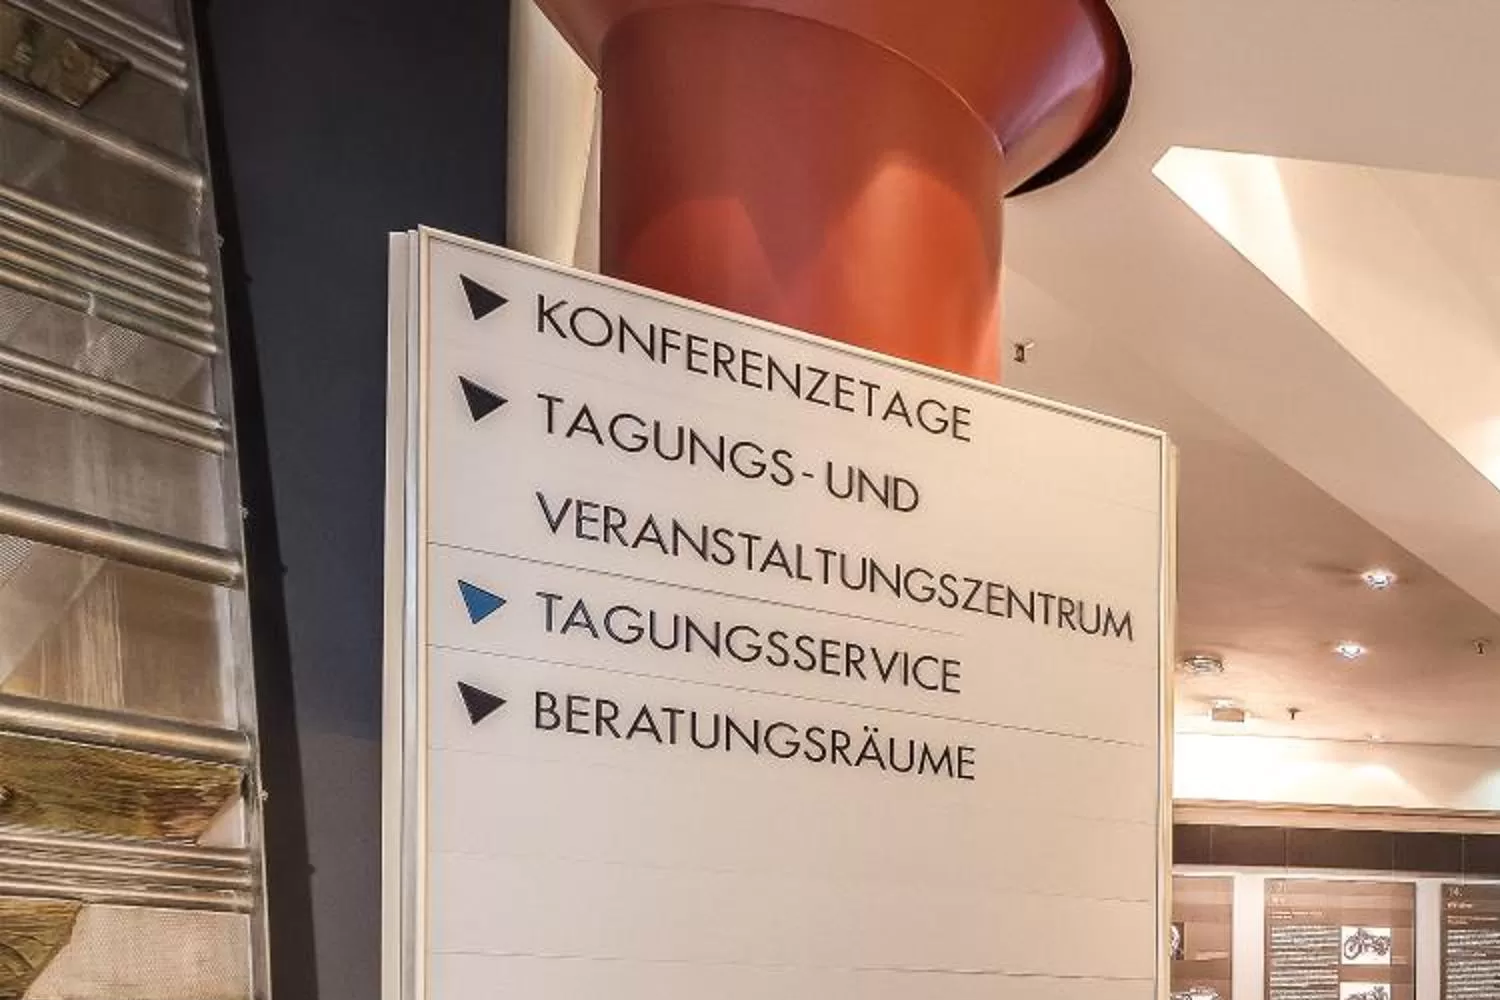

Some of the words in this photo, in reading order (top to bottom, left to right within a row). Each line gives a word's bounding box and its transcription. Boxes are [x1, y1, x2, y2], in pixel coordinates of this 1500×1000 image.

[537, 294, 971, 442] KONFERENZETAGE
[537, 393, 814, 488] TAGUNGS-
[827, 461, 919, 513] UND
[535, 491, 1133, 641] VERANSTALTUNGSZENTRUM
[535, 591, 961, 694] TAGUNGSSERVICE
[535, 691, 975, 781] BERATUNGSRÄUME
